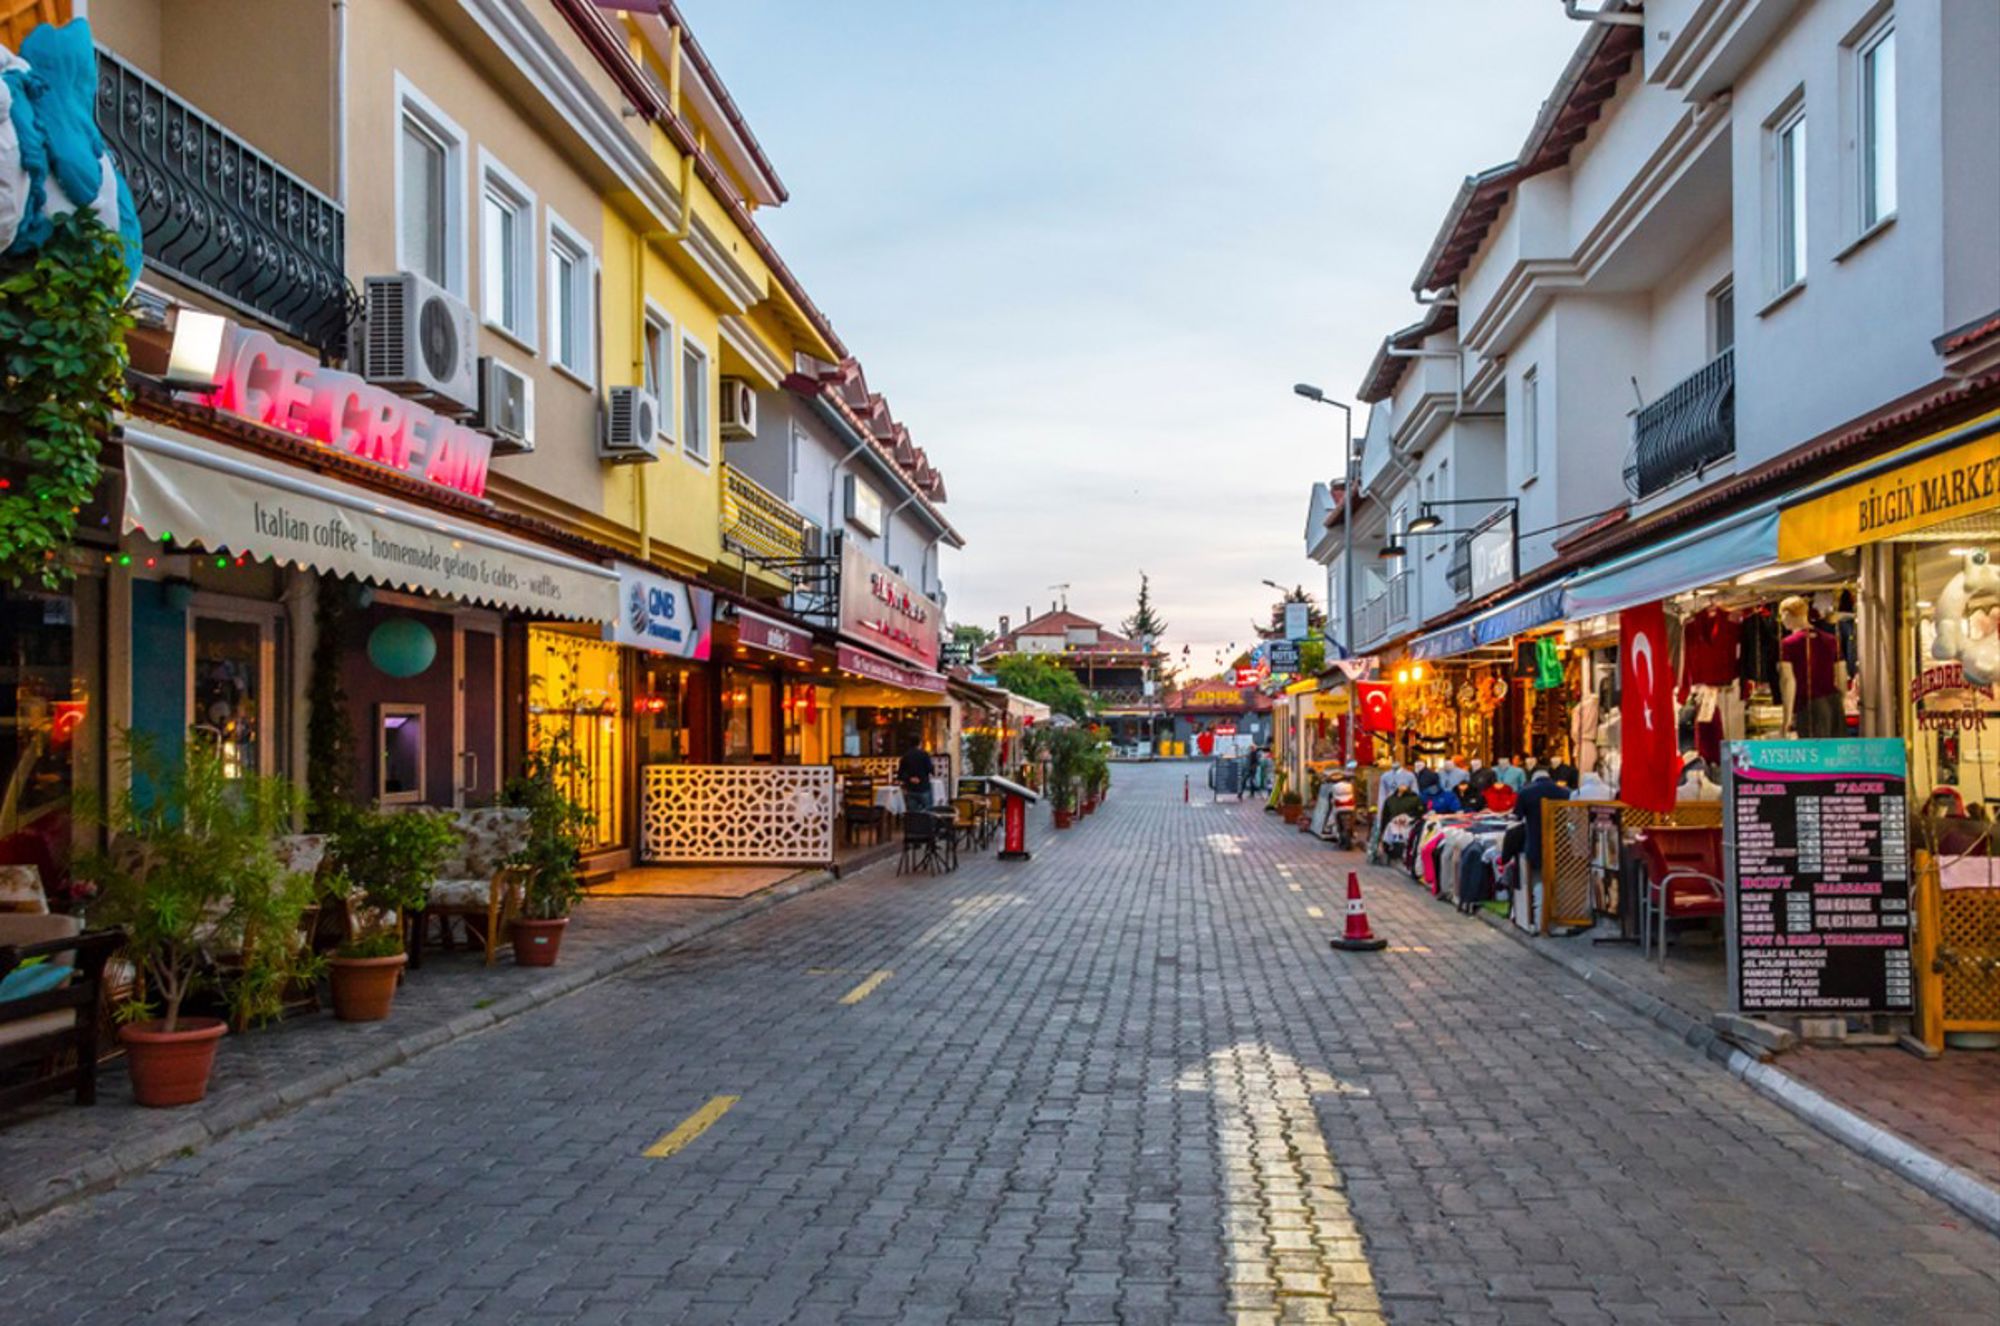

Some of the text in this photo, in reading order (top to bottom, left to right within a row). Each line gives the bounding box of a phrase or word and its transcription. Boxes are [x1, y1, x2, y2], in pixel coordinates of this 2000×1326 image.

[207, 320, 320, 438] ICE
[321, 367, 494, 499] CREAM
[1859, 478, 1915, 532] BİLGİN
[254, 502, 309, 544] Italian
[313, 519, 358, 552] coffee
[371, 530, 441, 572] homemade
[443, 553, 478, 580] gelato
[480, 560, 490, 584] &
[491, 564, 519, 590] cakes
[530, 574, 562, 600] waffles
[649, 587, 675, 619] QNB
